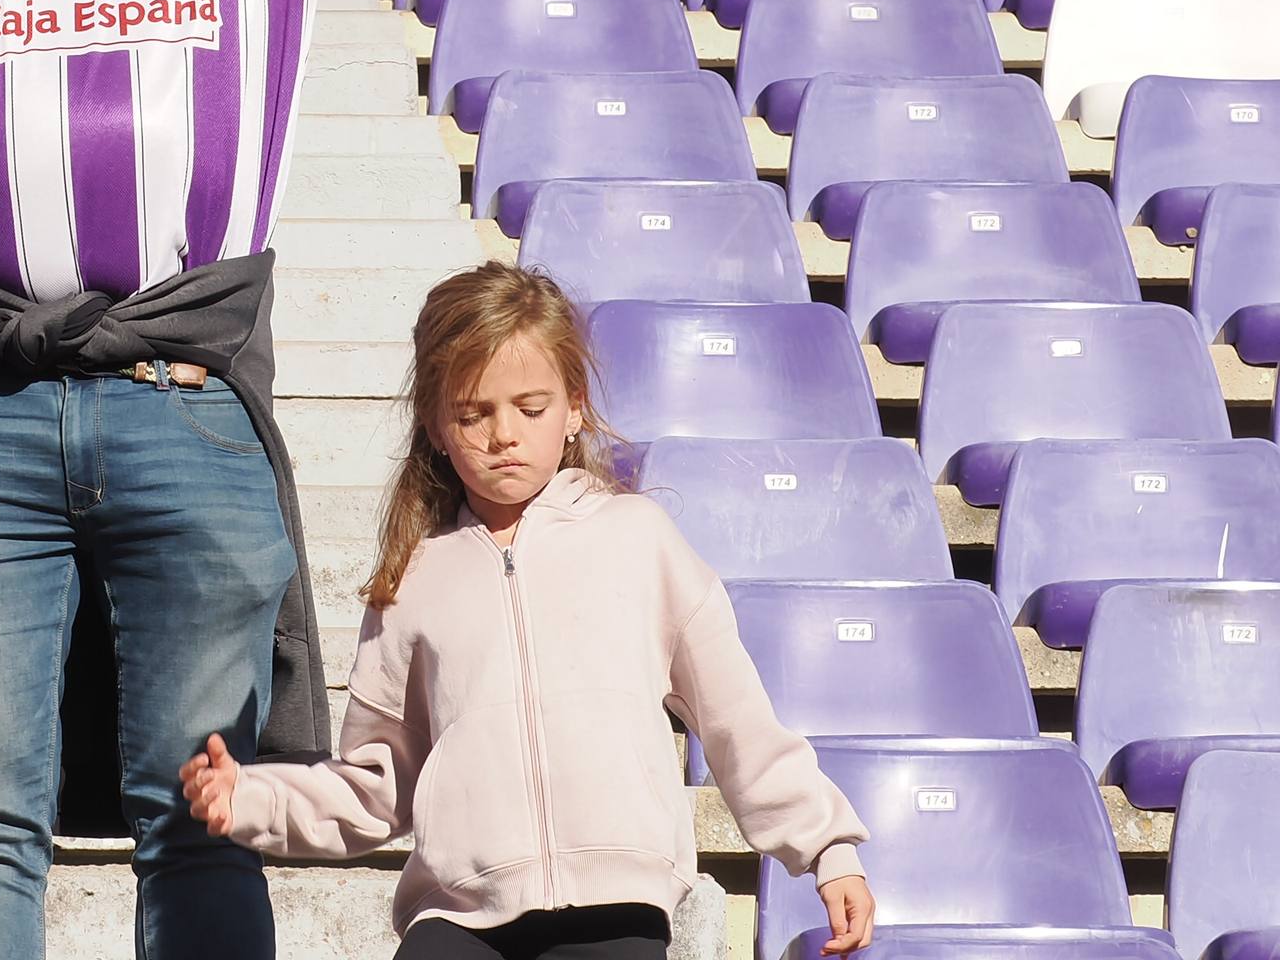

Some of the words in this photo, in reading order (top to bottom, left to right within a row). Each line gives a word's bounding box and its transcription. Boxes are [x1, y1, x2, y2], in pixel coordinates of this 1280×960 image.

[603, 104, 621, 112] 174
[914, 108, 932, 117] 172
[1236, 111, 1253, 119] 170
[647, 218, 666, 227] 174
[977, 219, 996, 227] 172
[710, 342, 729, 351] 174
[771, 477, 791, 486] 174
[1140, 480, 1161, 489] 172
[844, 627, 866, 637] 174
[1230, 629, 1252, 639] 172
[925, 795, 948, 805] 174
